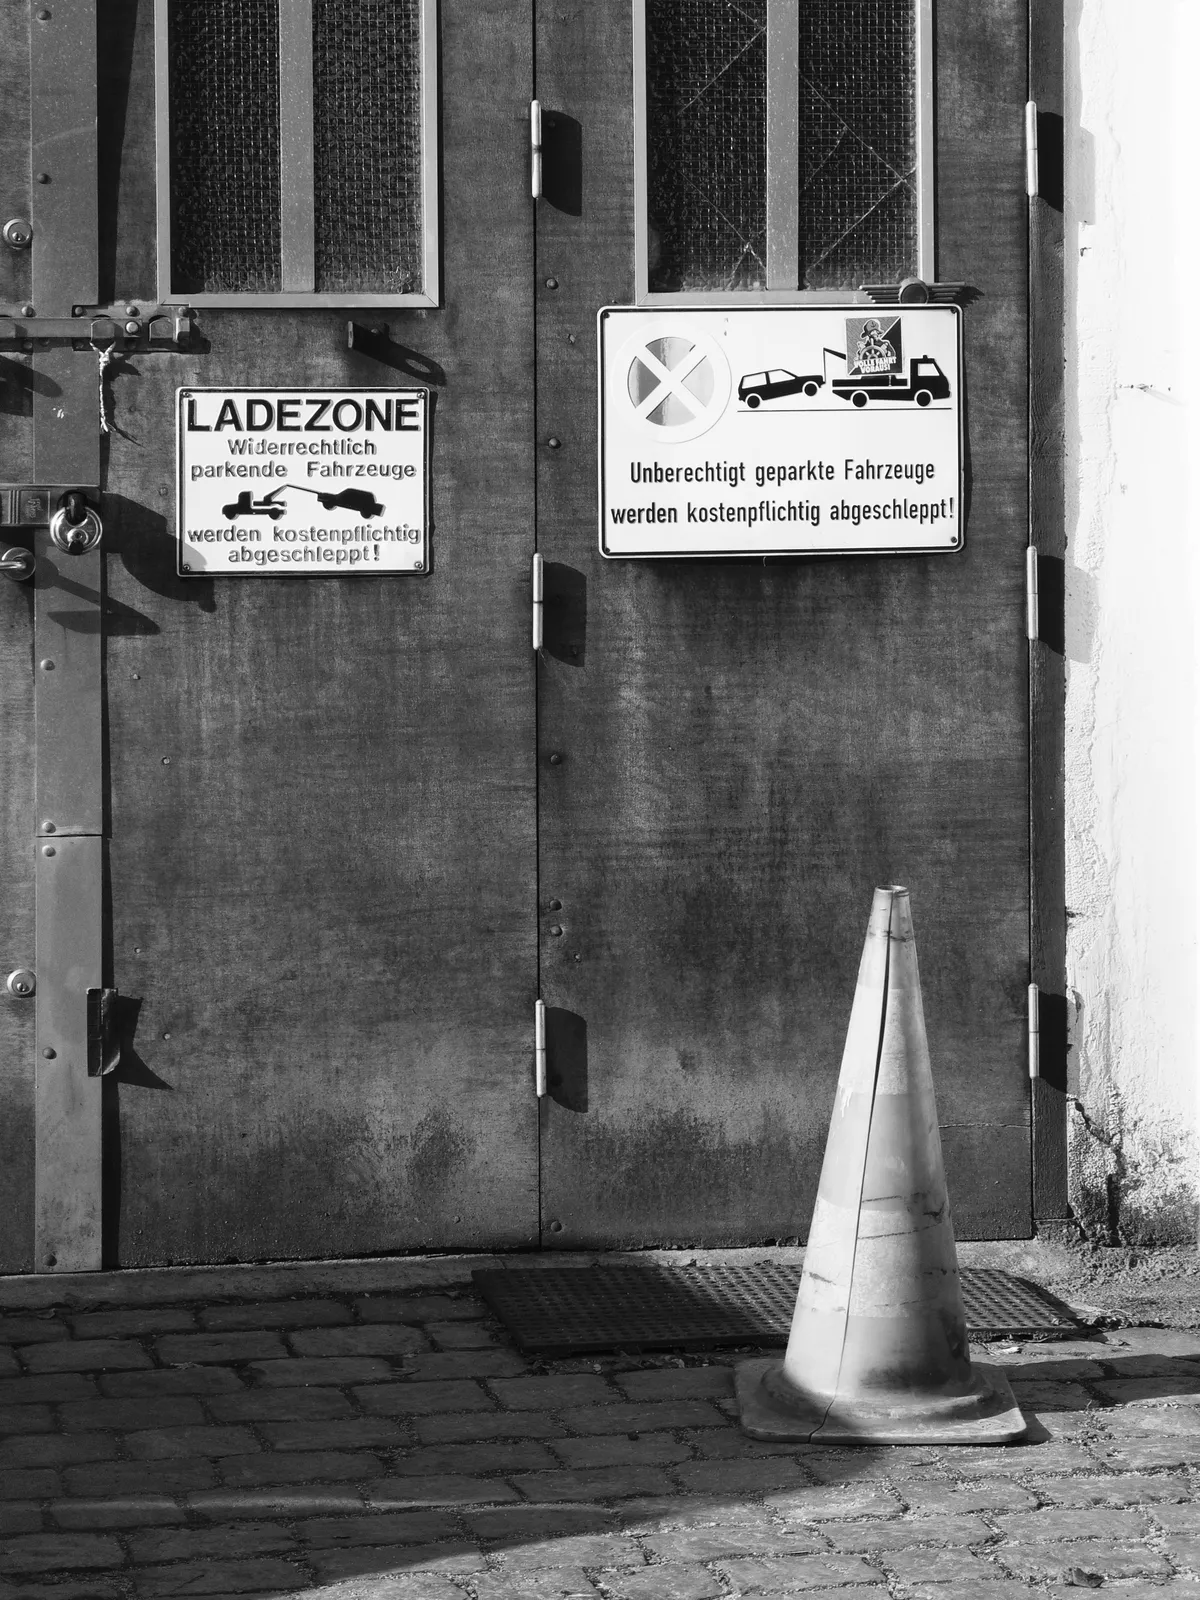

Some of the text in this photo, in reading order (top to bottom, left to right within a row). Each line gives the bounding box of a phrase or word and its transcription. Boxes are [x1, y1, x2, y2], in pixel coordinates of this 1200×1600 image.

[187, 398, 422, 432] LADEZONE
[227, 437, 377, 456] Widerrechtlich
[191, 460, 417, 481] parkende Fahrzeuge
[630, 458, 935, 488] Unberechtigt geparkte Fahrzeuge
[610, 497, 955, 528] werden kostenpflichtig abgeschleppt!
[187, 523, 422, 546] werden kostenpflichtig
[228, 543, 381, 565] abgeschleppt!
